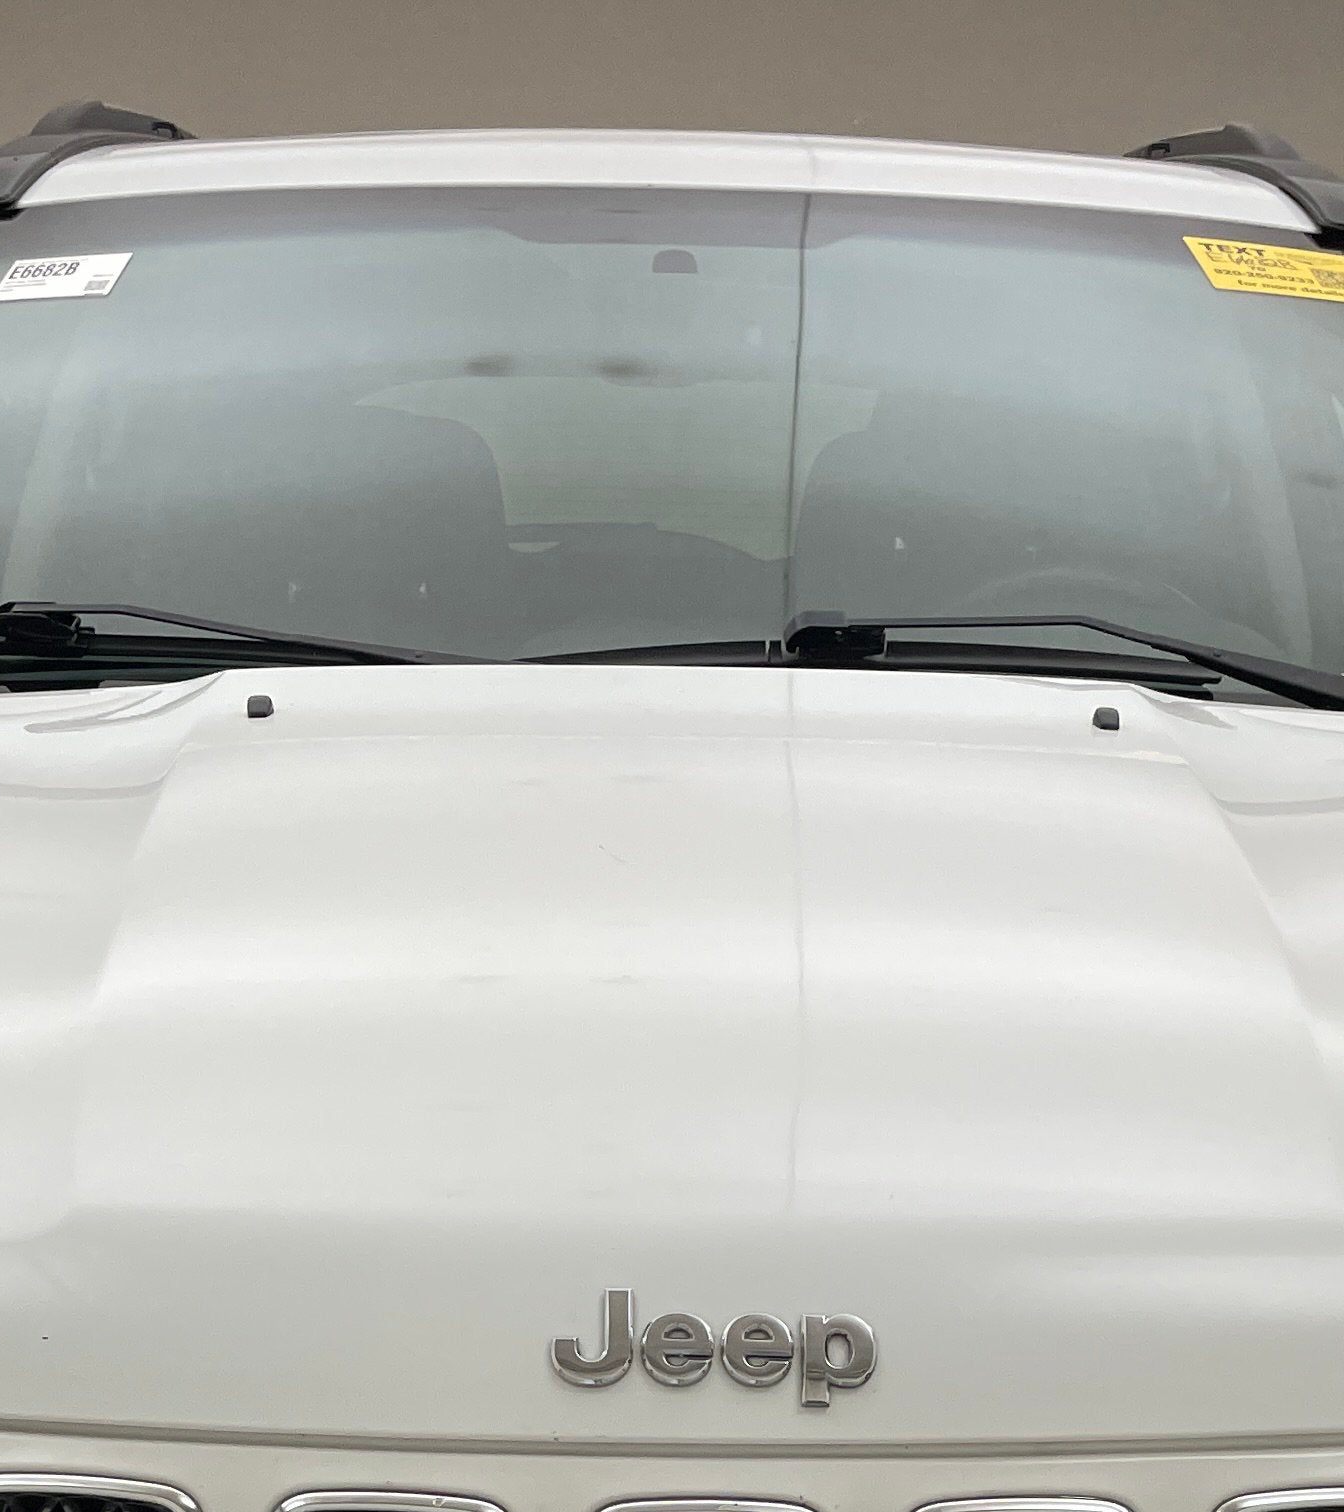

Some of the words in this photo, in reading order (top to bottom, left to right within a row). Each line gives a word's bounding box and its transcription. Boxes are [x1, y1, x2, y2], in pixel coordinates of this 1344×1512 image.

[1198, 242, 1265, 257] TEXT
[8, 261, 81, 280] E6682B
[551, 1287, 879, 1408] Jeep
